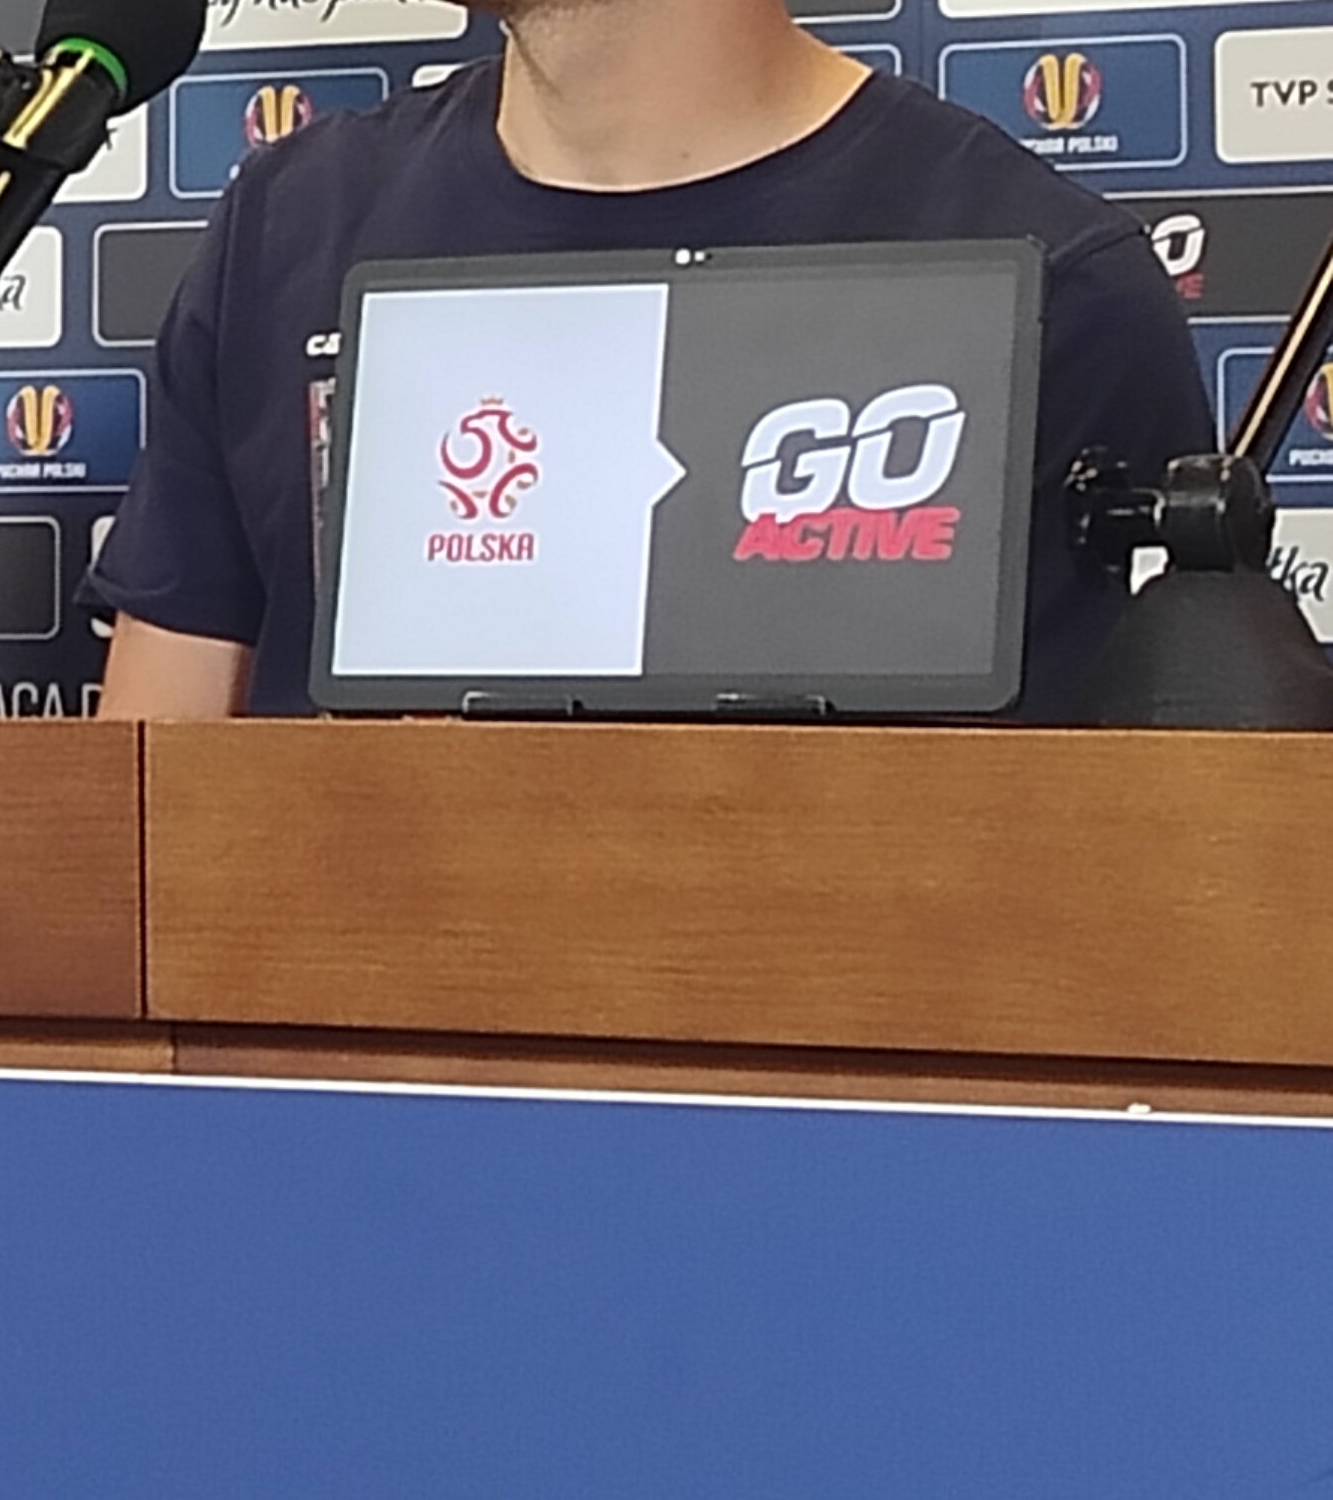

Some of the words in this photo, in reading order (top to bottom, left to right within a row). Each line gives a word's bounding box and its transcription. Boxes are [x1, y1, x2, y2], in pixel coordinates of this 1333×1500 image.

[1250, 80, 1317, 107] TVP
[741, 384, 966, 523] GO
[427, 533, 534, 562] POLSKA
[732, 506, 962, 560] ACTIVE
